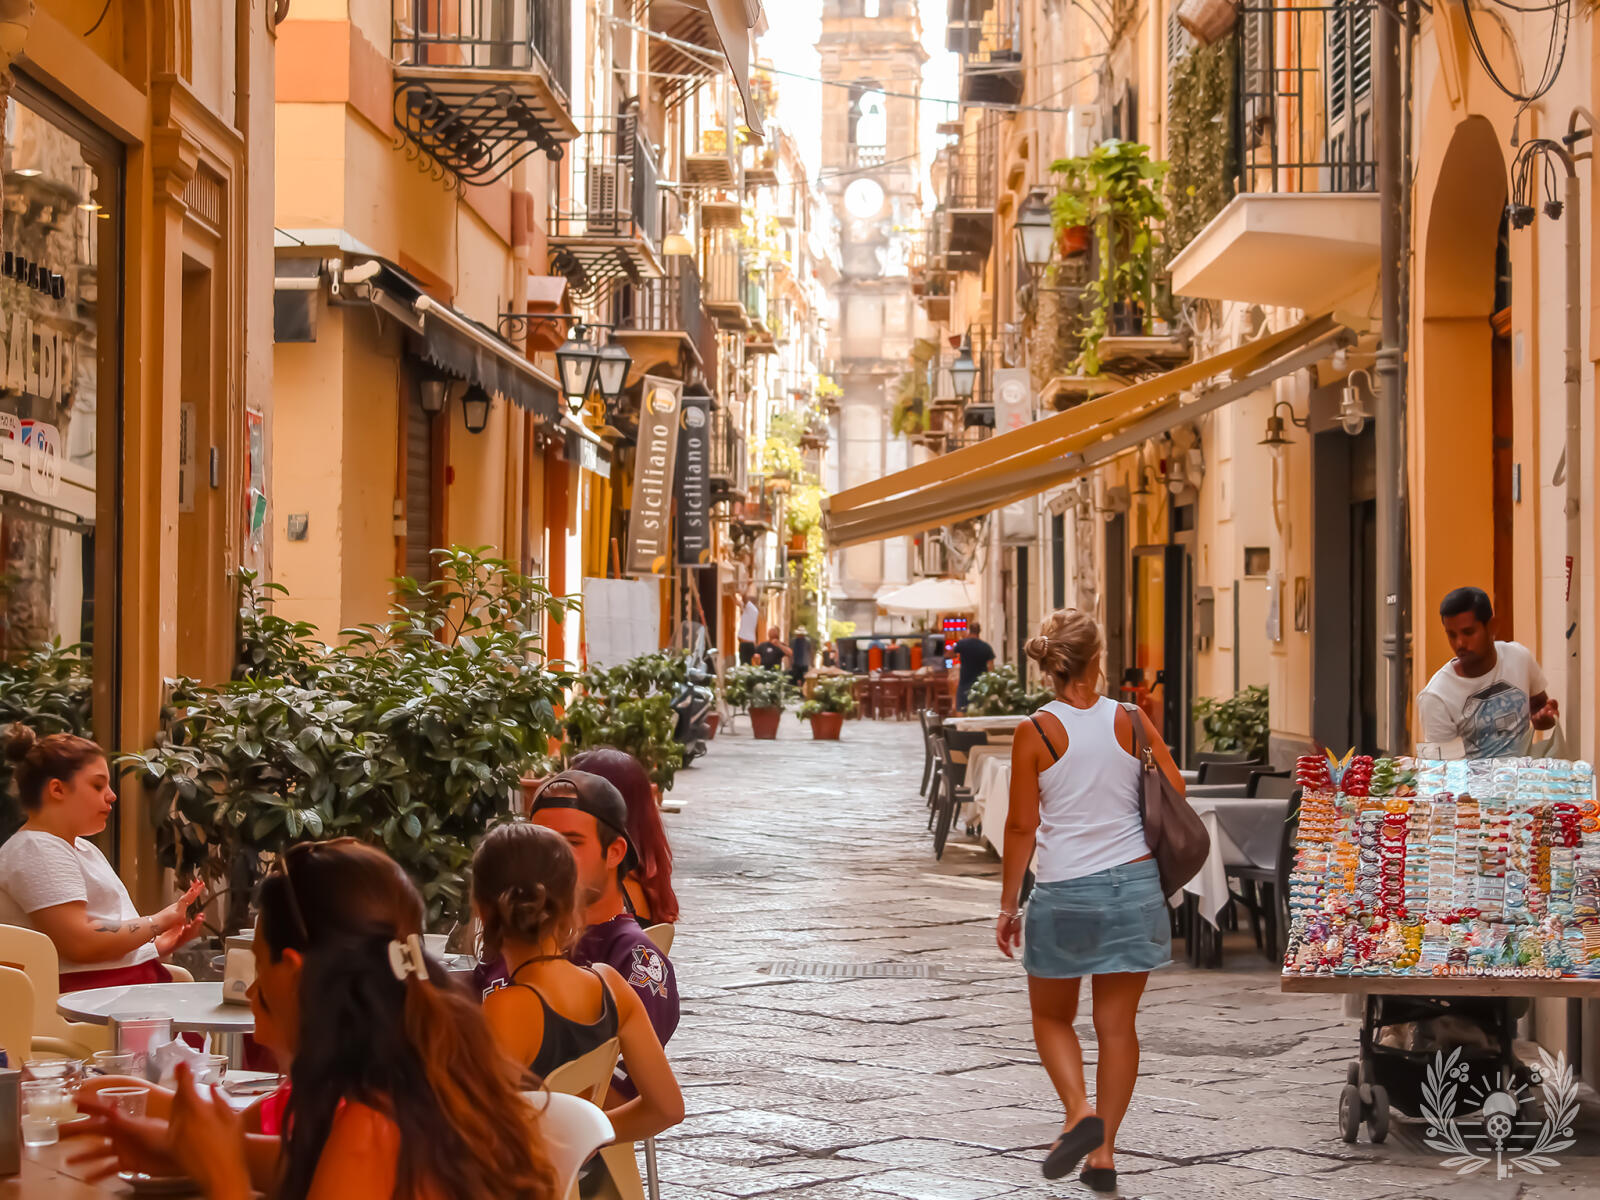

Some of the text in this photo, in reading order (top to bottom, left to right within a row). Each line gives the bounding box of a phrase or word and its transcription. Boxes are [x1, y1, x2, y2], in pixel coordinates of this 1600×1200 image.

[641, 424, 669, 530] siciliano
[683, 437, 703, 549] il siciliano
[636, 539, 659, 555] il
